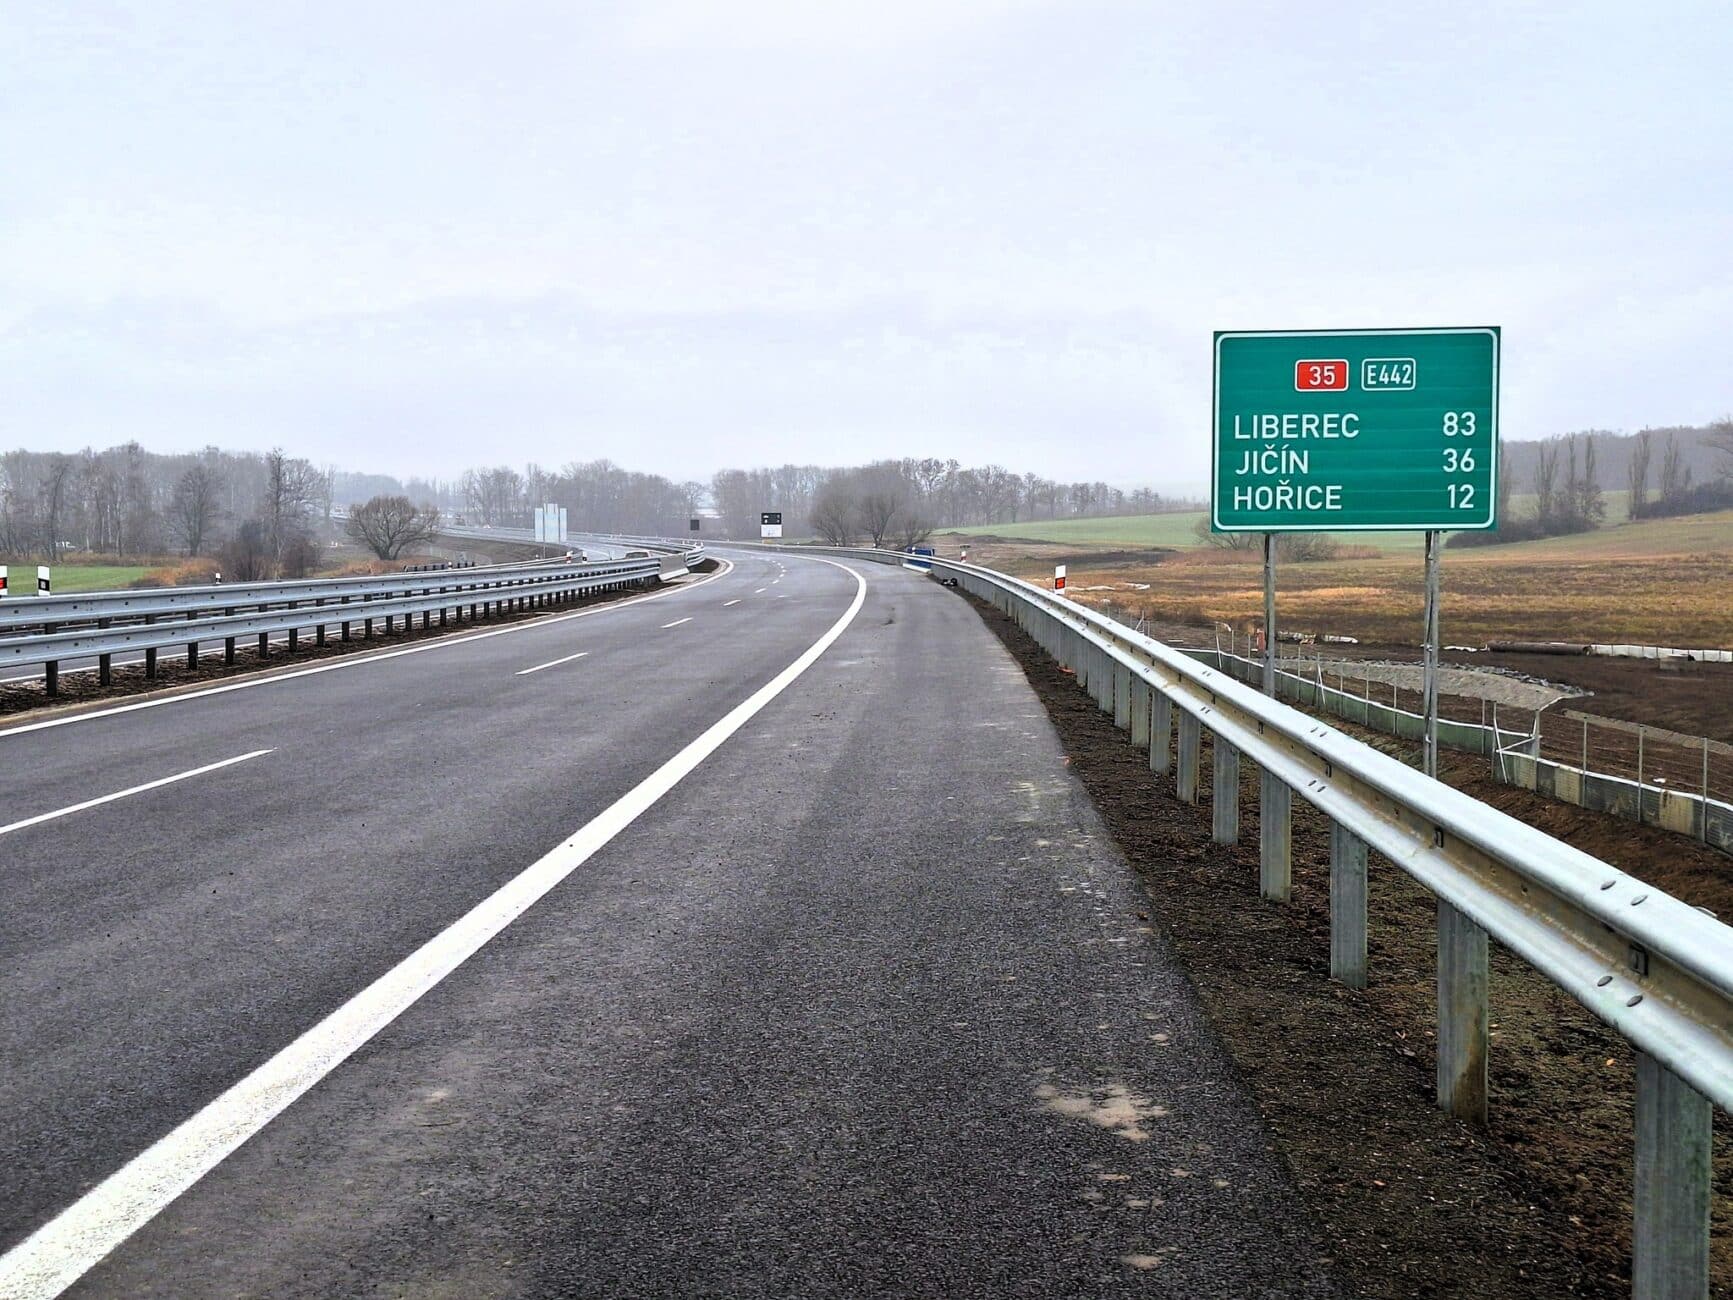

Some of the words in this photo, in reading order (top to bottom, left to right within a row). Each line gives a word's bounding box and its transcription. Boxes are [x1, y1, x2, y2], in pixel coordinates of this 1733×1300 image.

[1309, 365, 1336, 386] 35
[1367, 364, 1413, 385] E442
[1234, 413, 1360, 440] LIBEREC
[1442, 411, 1477, 437] 83
[1235, 444, 1309, 475] JIČÍN
[1442, 447, 1476, 473] 36
[1234, 480, 1343, 511] HOŘICE
[1447, 484, 1475, 509] 12
